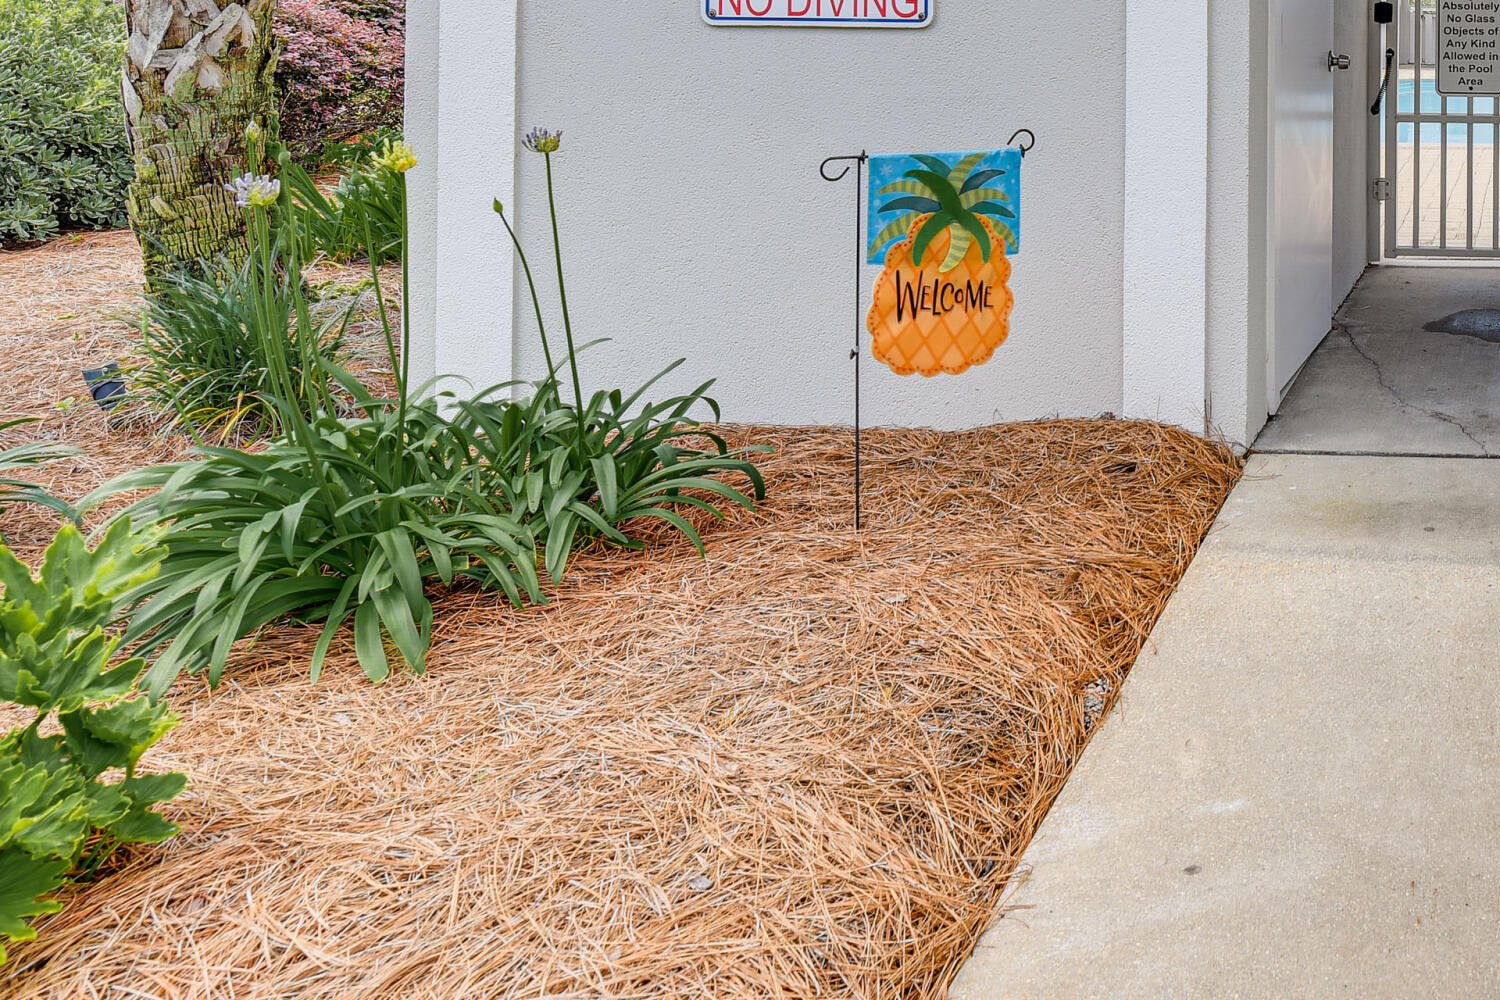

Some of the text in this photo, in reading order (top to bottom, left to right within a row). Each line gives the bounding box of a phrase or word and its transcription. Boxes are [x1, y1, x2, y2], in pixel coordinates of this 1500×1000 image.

[1442, 2, 1500, 12] Absolutely
[1447, 14, 1495, 23] No Glass
[1443, 27, 1499, 37] Objects of
[1446, 40, 1496, 49] Any Kind
[1442, 52, 1498, 61] Allowed in
[1448, 65, 1493, 73] the Pool
[1458, 77, 1483, 86] Area
